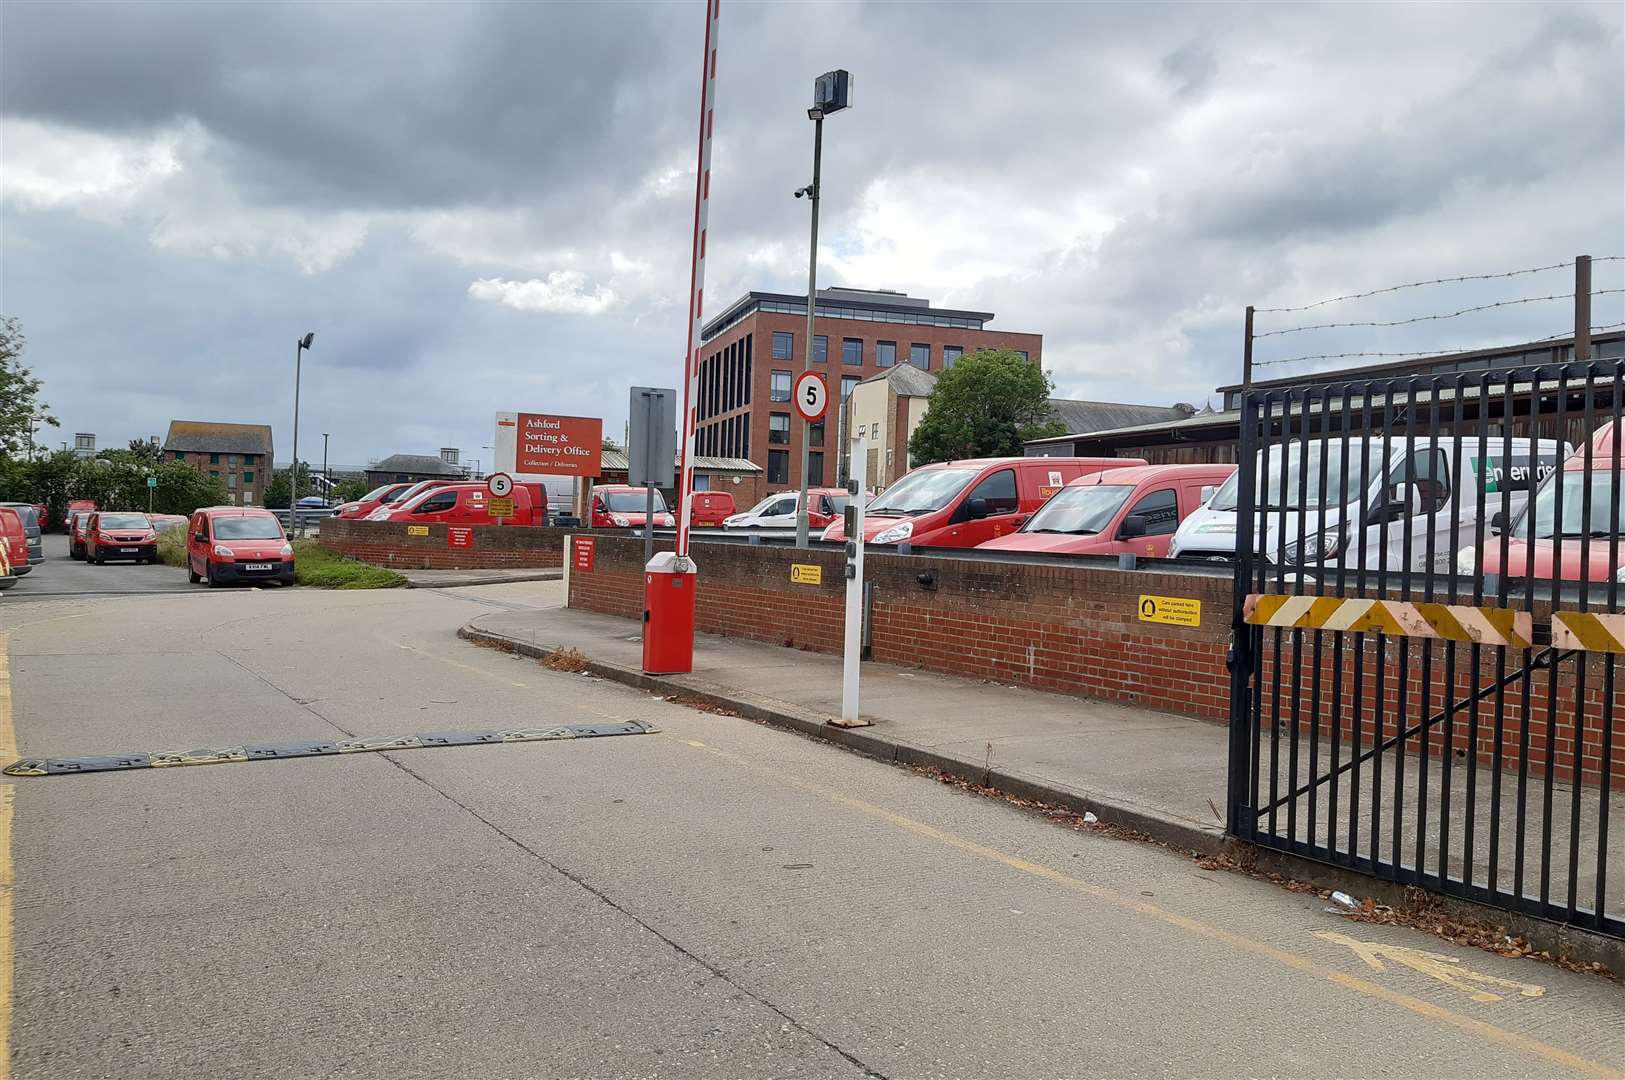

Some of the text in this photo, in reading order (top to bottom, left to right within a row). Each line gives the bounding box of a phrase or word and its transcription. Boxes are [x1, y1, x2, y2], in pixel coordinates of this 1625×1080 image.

[806, 386, 817, 405] 5
[526, 419, 560, 429] Ashford
[525, 431, 568, 443] Sorting &
[525, 444, 590, 456] Delivery Office
[497, 480, 504, 490] 5
